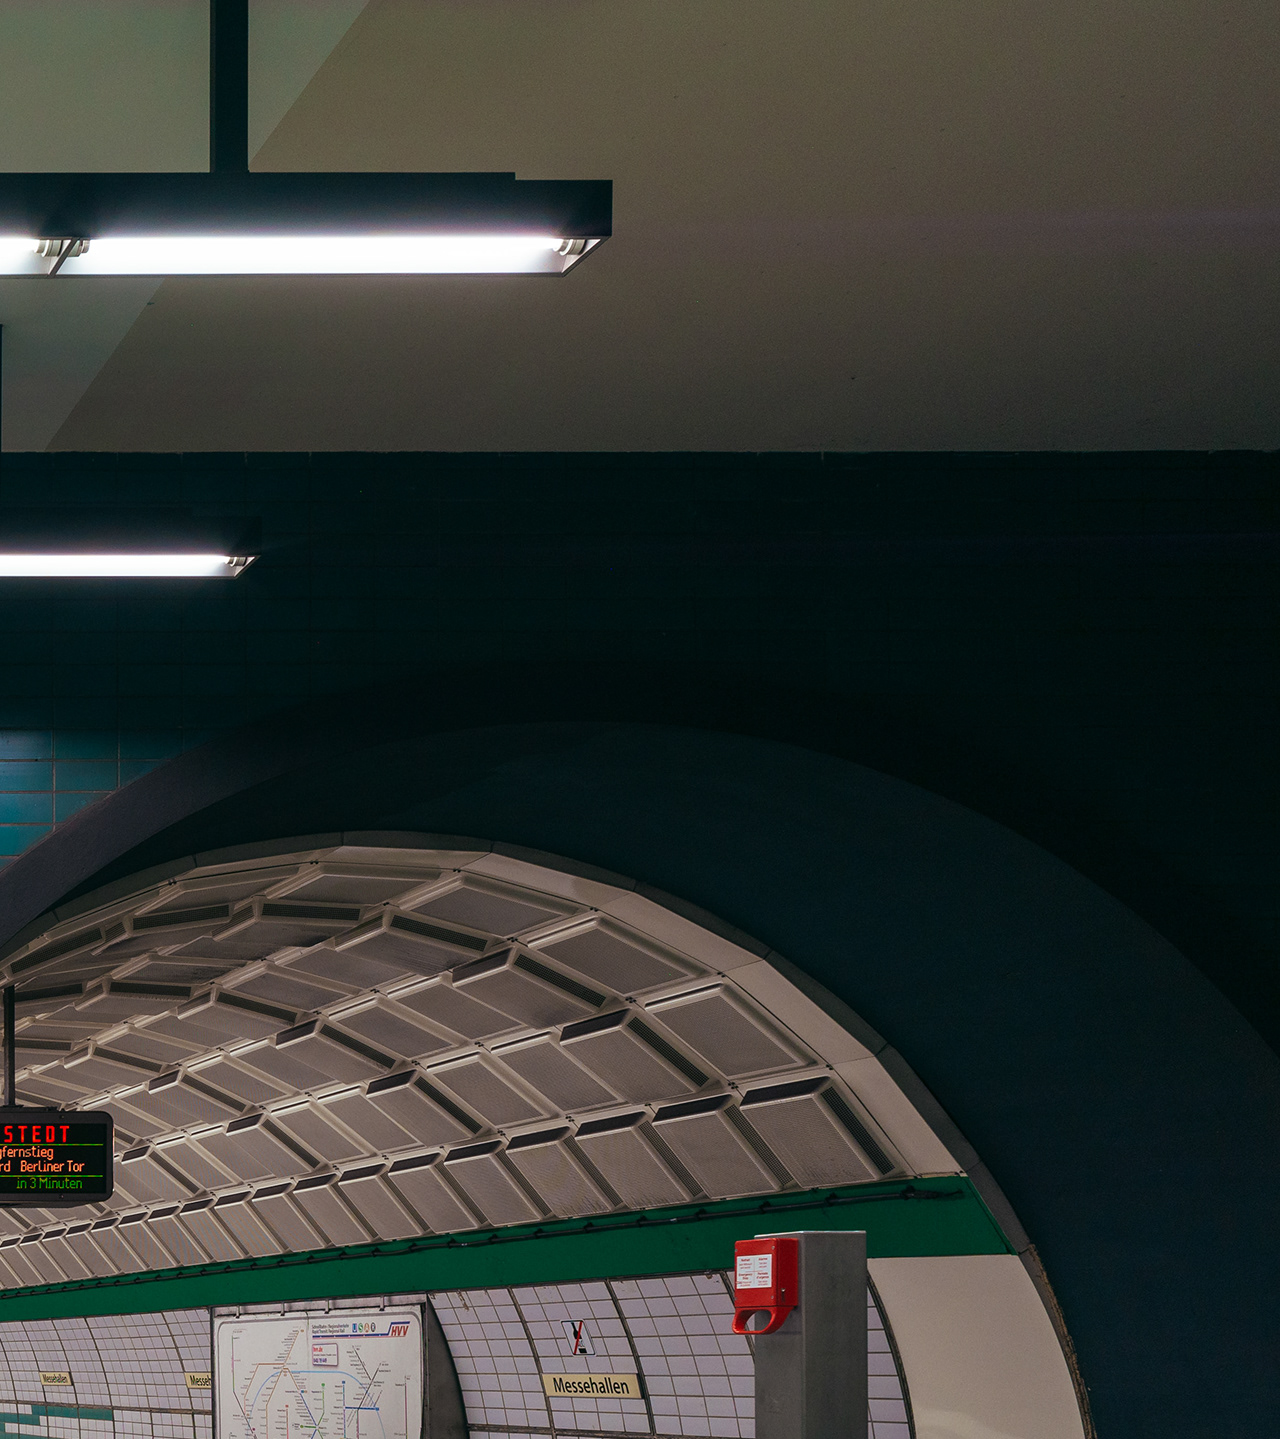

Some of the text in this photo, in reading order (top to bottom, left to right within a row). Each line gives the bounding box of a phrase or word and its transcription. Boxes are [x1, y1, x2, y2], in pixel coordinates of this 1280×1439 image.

[20, 1160, 64, 1172] Berliner
[66, 1160, 85, 1172] Tor
[16, 1177, 83, 1189] in 3 Minuten
[391, 1325, 409, 1336] HVV
[190, 1374, 211, 1386] Messeh
[553, 1377, 629, 1394] Messehallen
